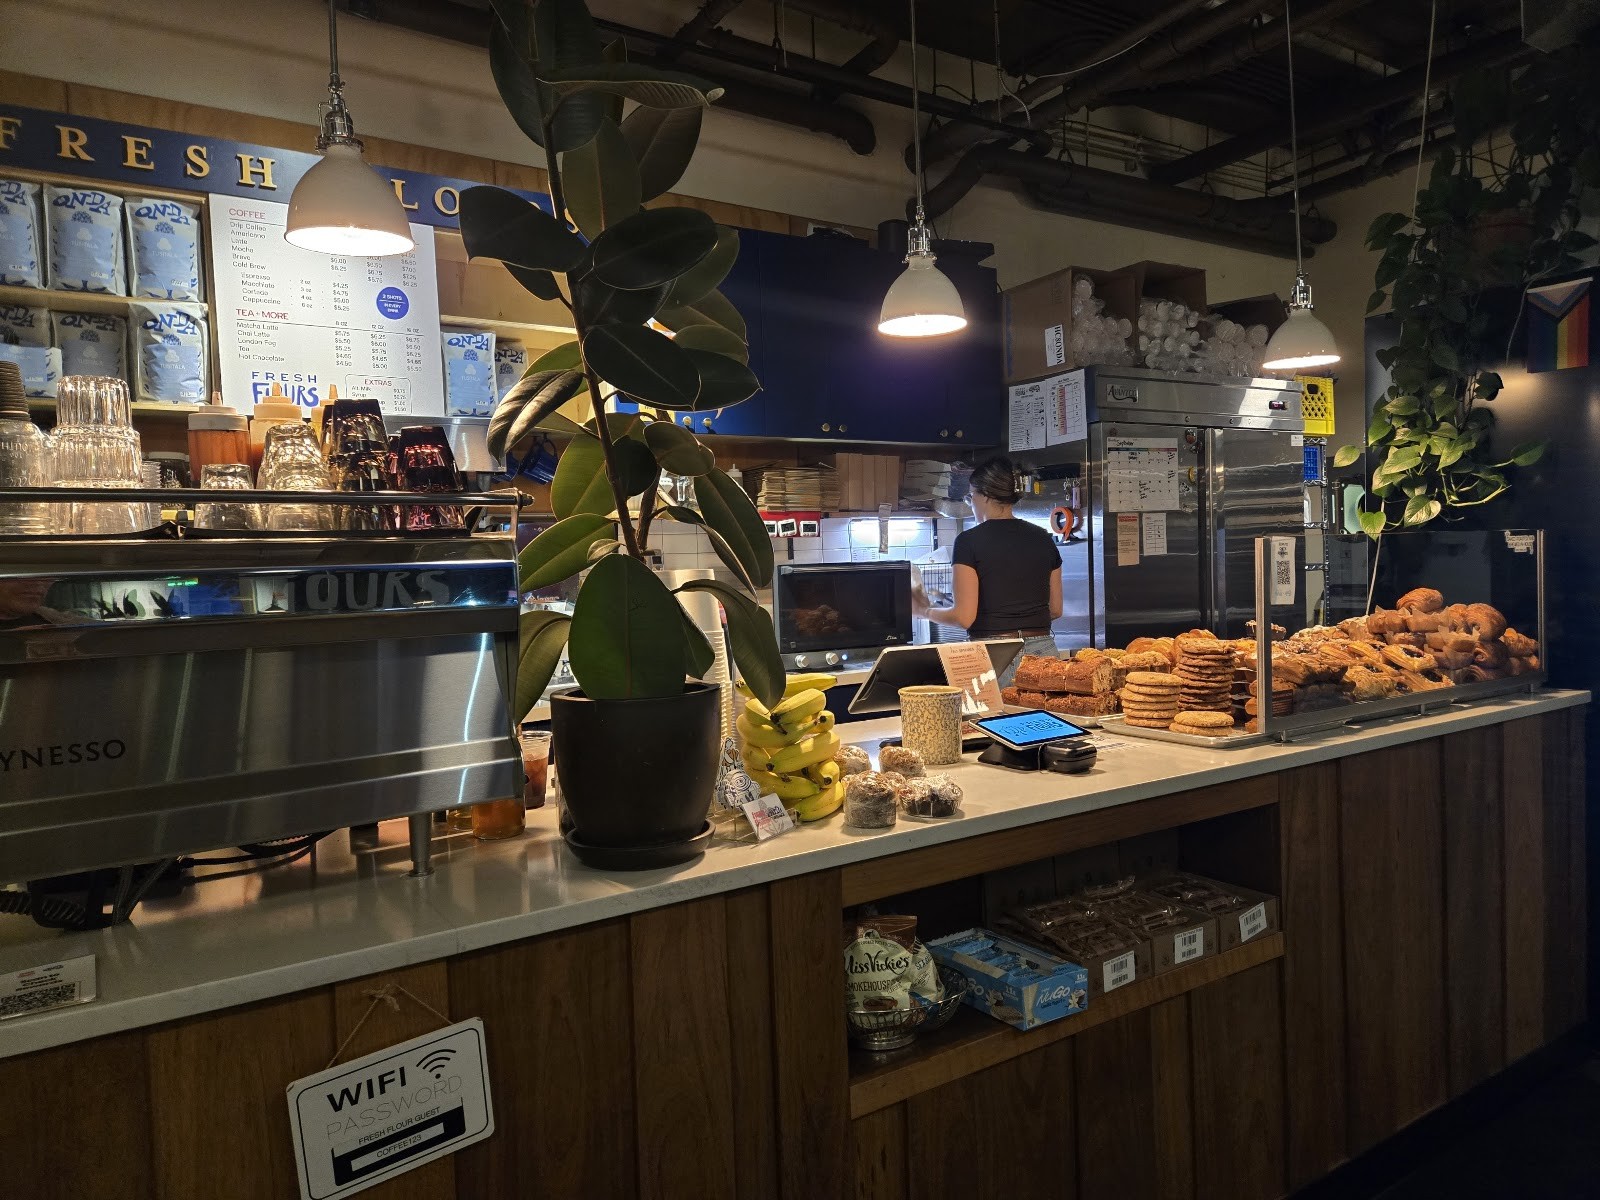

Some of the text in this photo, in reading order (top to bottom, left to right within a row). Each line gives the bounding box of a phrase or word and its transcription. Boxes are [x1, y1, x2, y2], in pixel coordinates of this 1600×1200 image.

[0, 117, 277, 191] FRESH
[53, 192, 111, 216] ONDA
[135, 203, 191, 226] ONDA
[229, 208, 266, 220] COFFEE
[230, 230, 266, 239] Americano
[245, 223, 267, 231] Coffee
[231, 237, 248, 245] Latte
[231, 245, 254, 253] Mocha
[241, 280, 275, 289] Macchiato
[142, 311, 197, 335] ONDA
[236, 309, 254, 317] TEA
[262, 310, 289, 320] MORE
[447, 334, 489, 351] ONDA
[494, 349, 523, 364] NDA
[252, 371, 317, 384] FRESH
[364, 379, 392, 387] EXTRAS
[0, 740, 126, 771] YNESSO
[864, 950, 910, 975] Vickie's
[326, 1066, 407, 1113] WIFI
[326, 1075, 462, 1140] PASSWORD
[358, 1106, 441, 1145] FRESH FLOUR GUEST
[376, 1134, 422, 1159] COFFEE123
